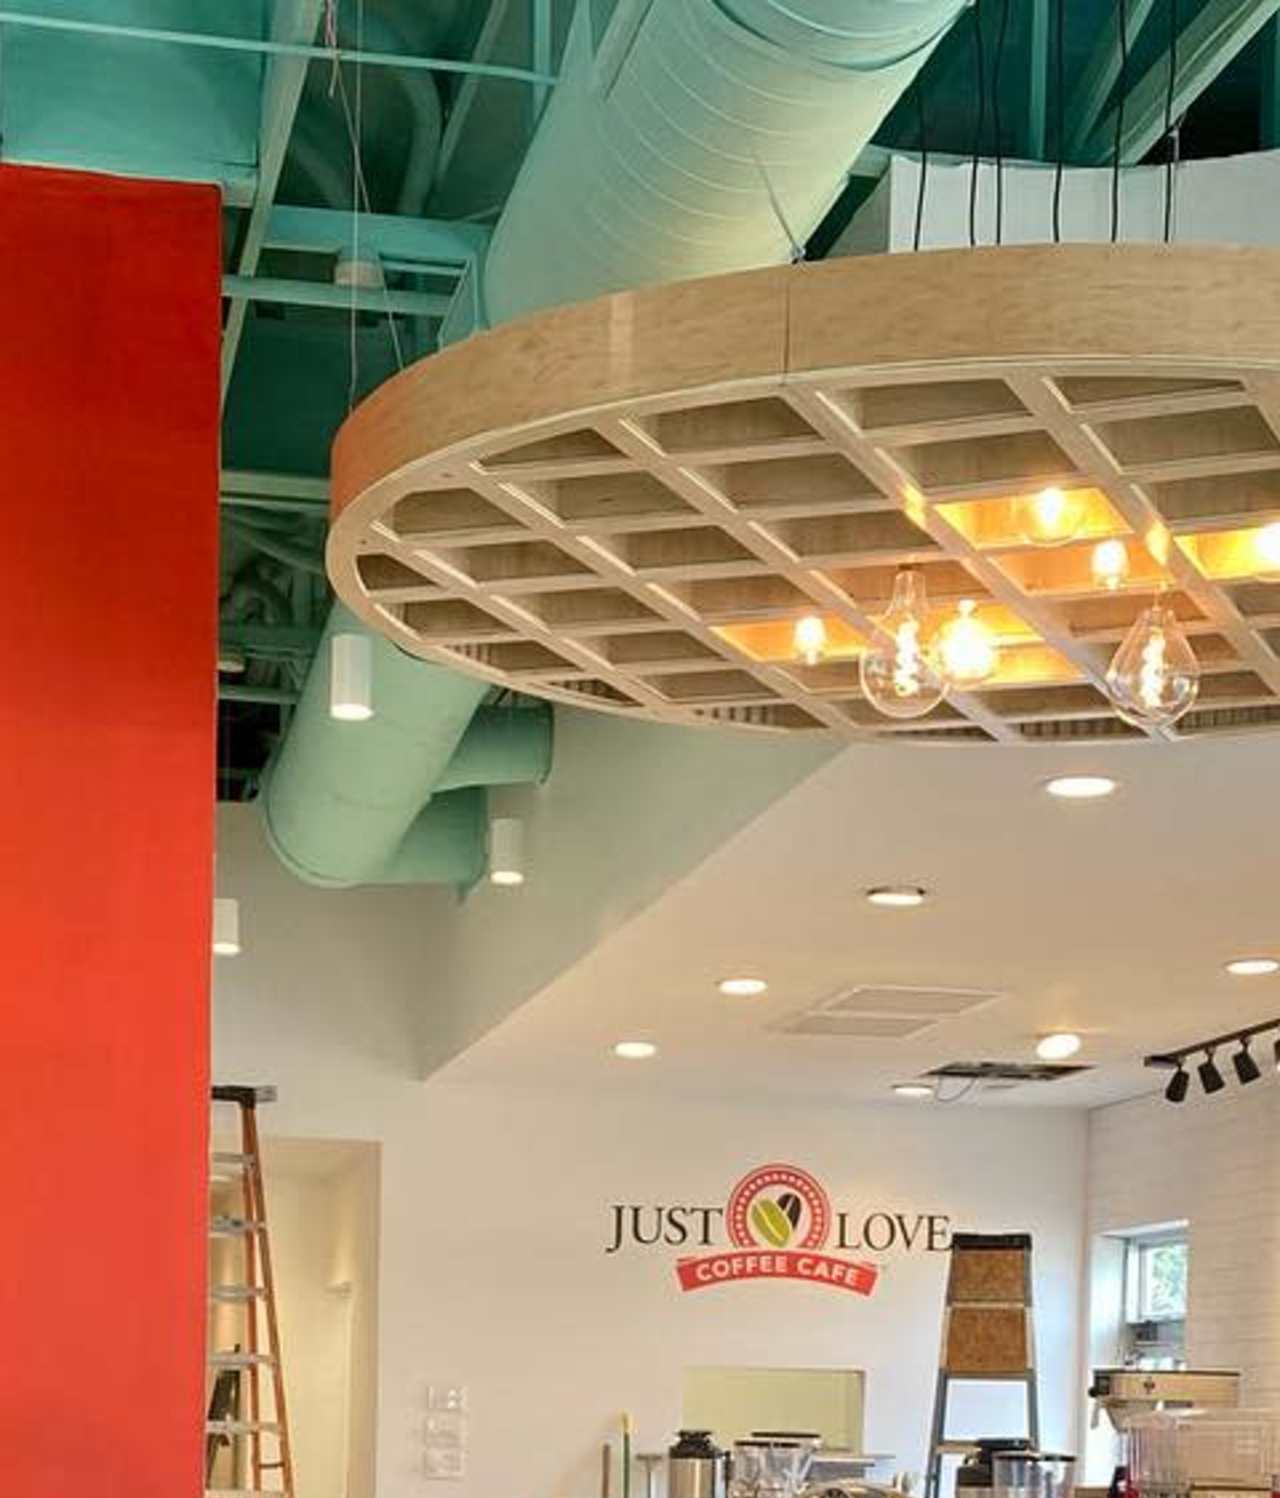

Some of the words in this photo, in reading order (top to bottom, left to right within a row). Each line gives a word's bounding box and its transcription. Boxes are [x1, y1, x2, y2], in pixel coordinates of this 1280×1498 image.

[605, 1205, 724, 1253] JUST
[836, 1212, 953, 1252] LOVE
[695, 1254, 788, 1282] COFFEE
[796, 1256, 861, 1286] CAFE
